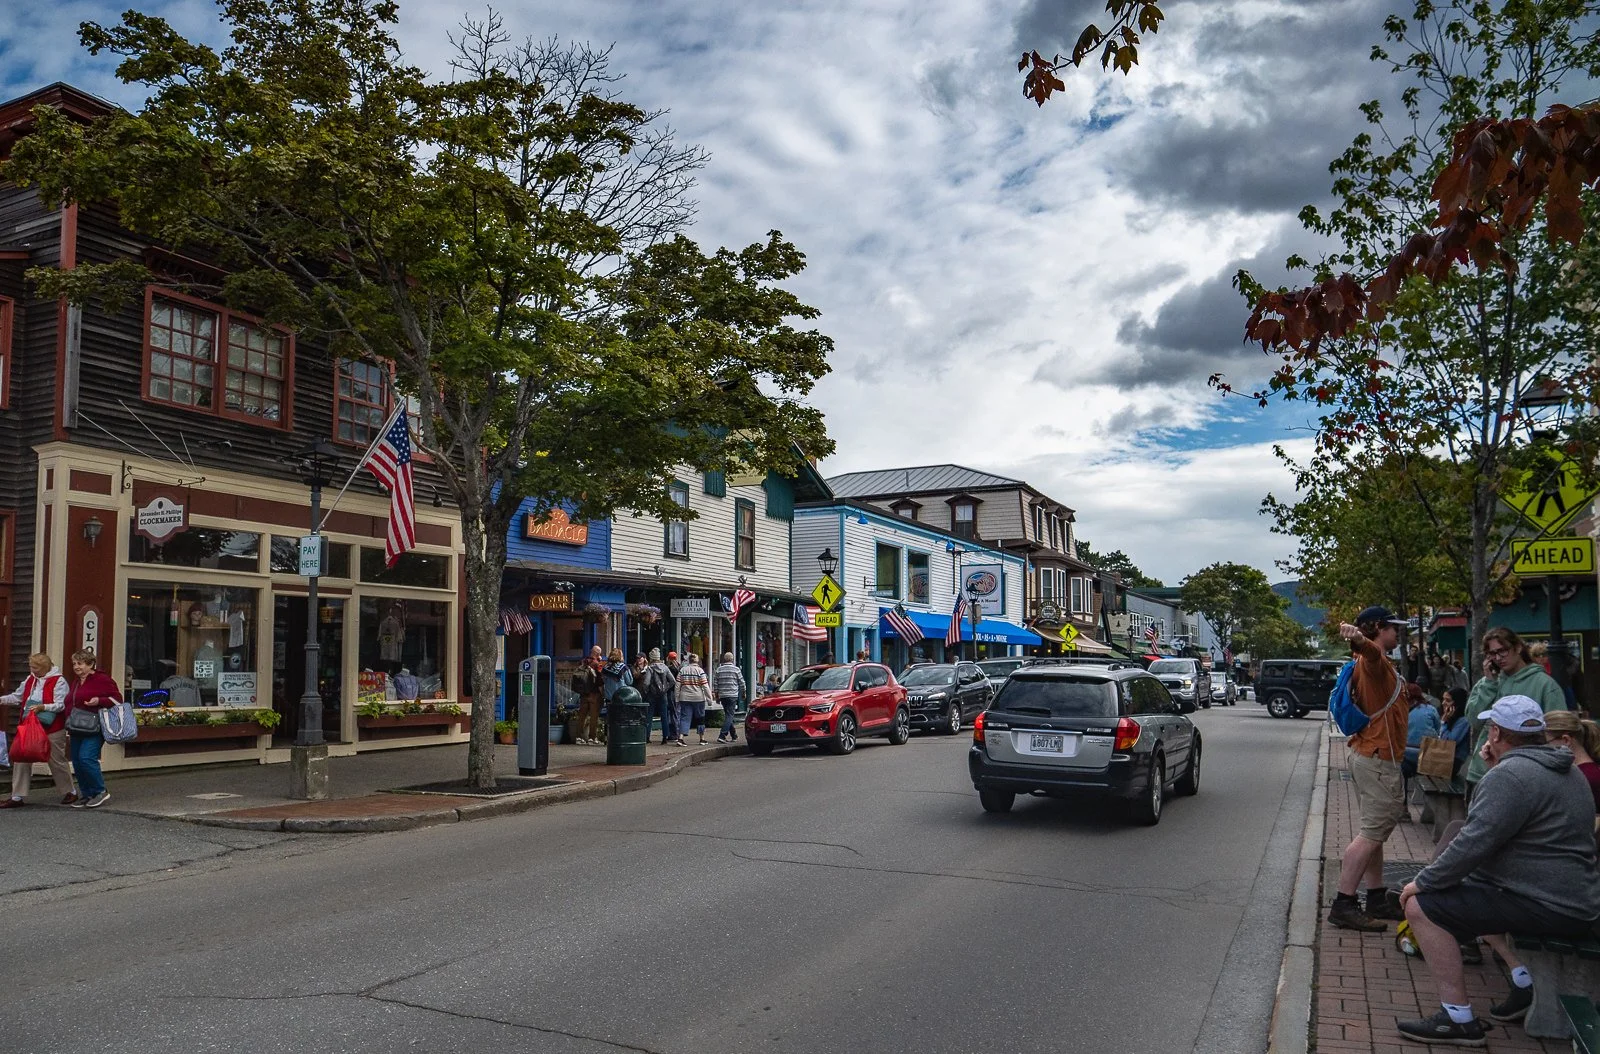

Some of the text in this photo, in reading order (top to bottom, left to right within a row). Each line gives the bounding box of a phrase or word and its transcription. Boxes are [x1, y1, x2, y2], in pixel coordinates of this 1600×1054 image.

[140, 516, 182, 525] CLOCKMAKER
[530, 518, 586, 542] BARNACLE
[302, 546, 316, 554] PAY
[1522, 547, 1584, 565] AHEAD
[302, 560, 318, 568] HERE
[531, 595, 569, 608] OYSTER
[818, 616, 838, 624] AHEAD
